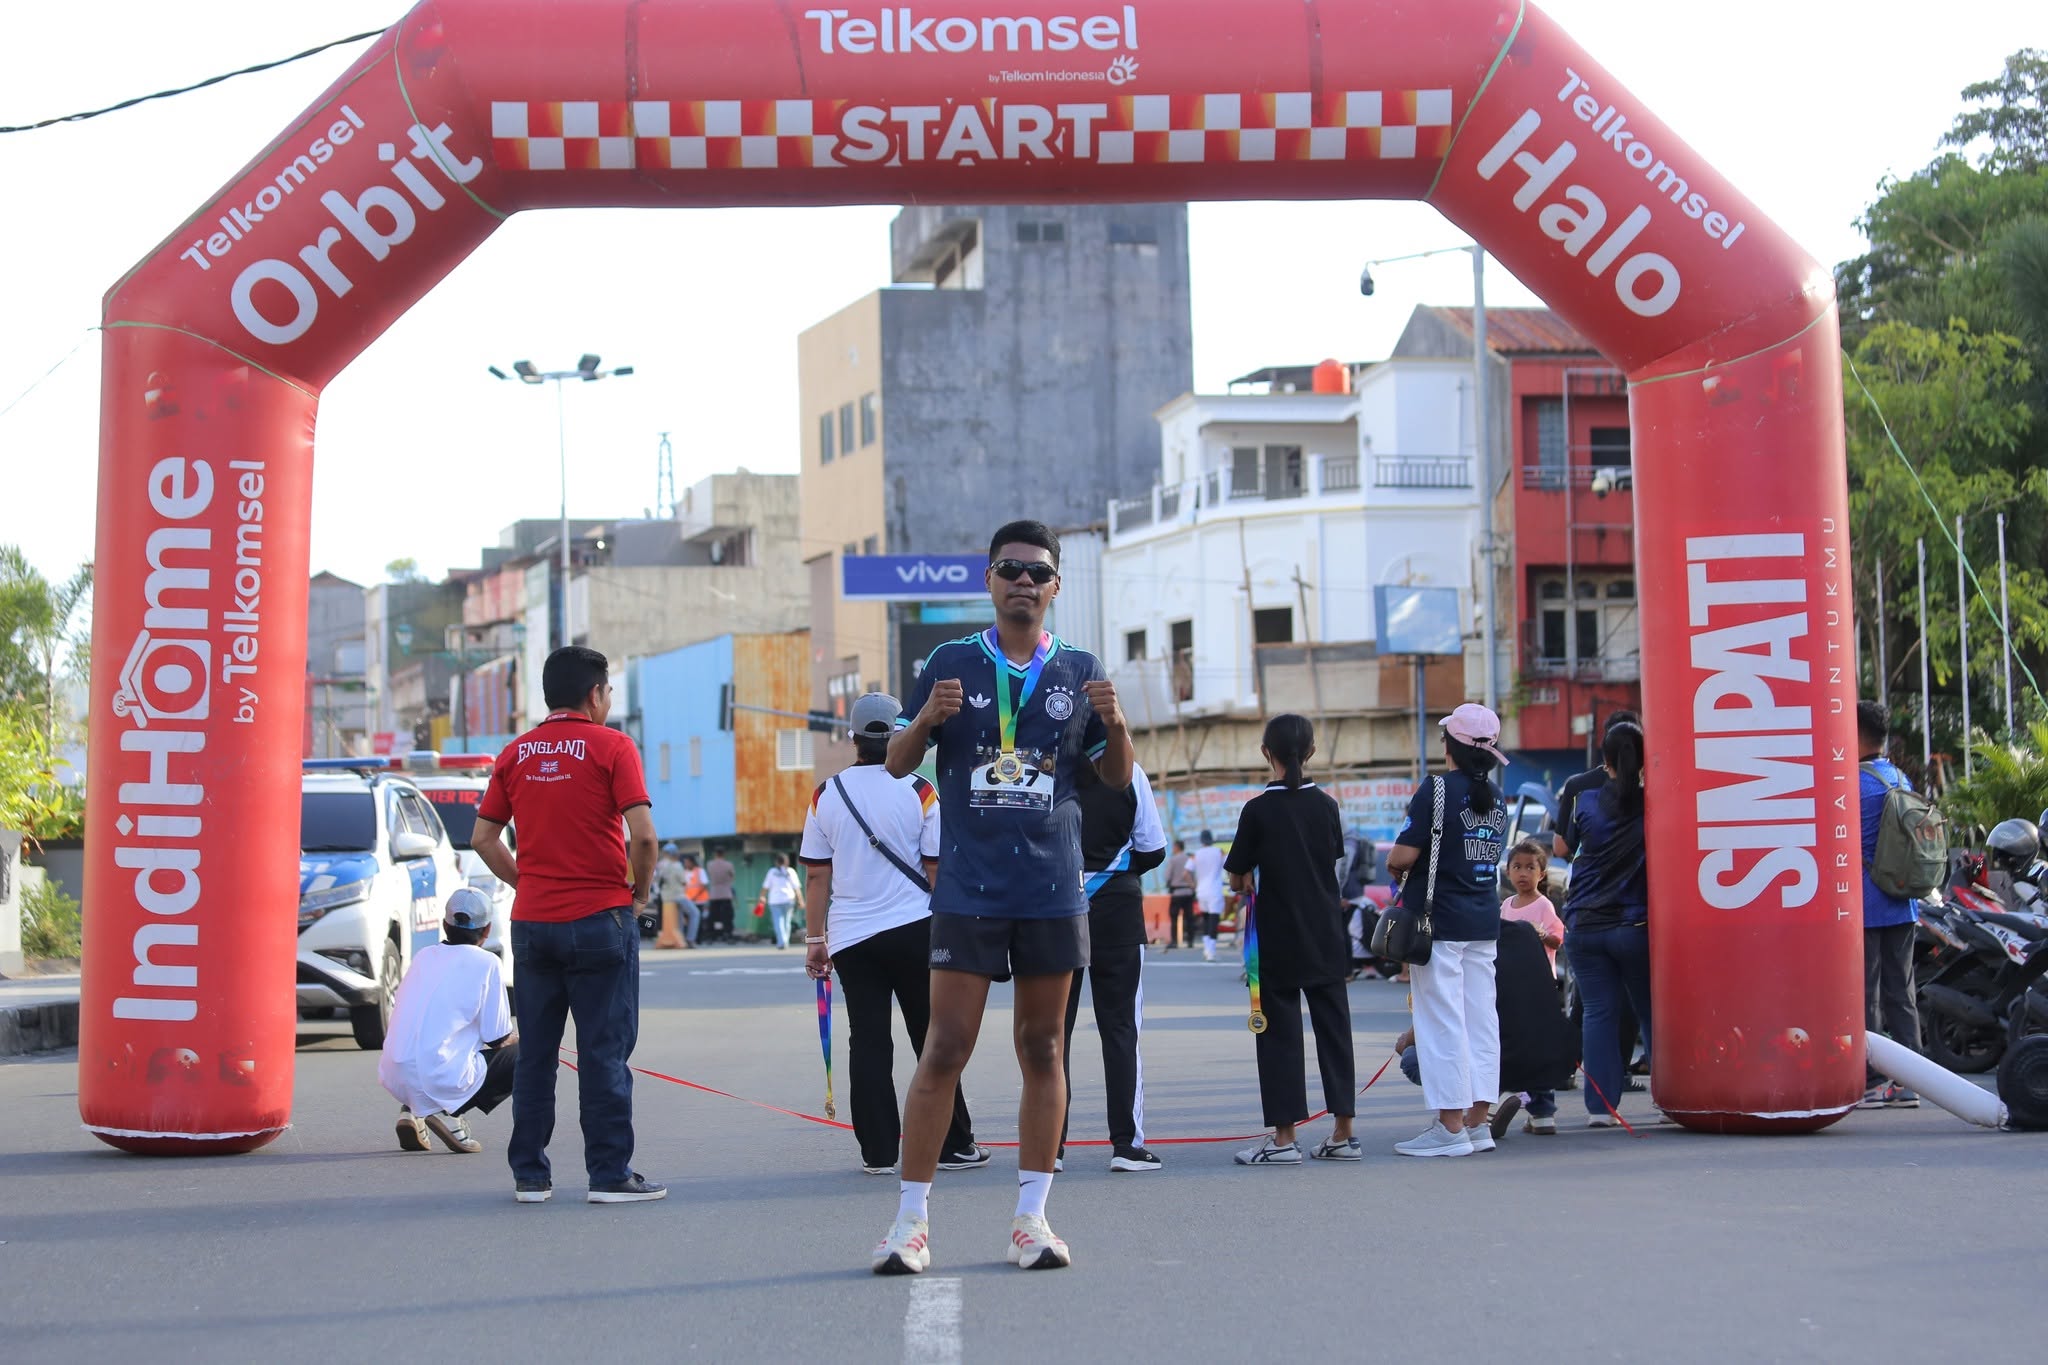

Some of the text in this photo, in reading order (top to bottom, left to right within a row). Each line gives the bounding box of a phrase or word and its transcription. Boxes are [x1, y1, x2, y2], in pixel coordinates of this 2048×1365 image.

[804, 4, 1139, 54] Telkomsel
[989, 69, 1105, 83] by Telkom Indonesia
[180, 104, 365, 270] Telkomsel
[840, 103, 1108, 162] START
[1476, 107, 1681, 317] Halo
[1557, 67, 1746, 250] Telkomsel
[230, 121, 484, 345] Orbit
[222, 460, 266, 724] by Telkomsel
[896, 560, 969, 583] vivo
[112, 456, 215, 1022] IndiHome
[516, 739, 586, 765] ENGLAND
[1686, 532, 1819, 910] SIMPATI
[1478, 828, 1493, 839] BY
[1832, 746, 1850, 921] TERBAIK
